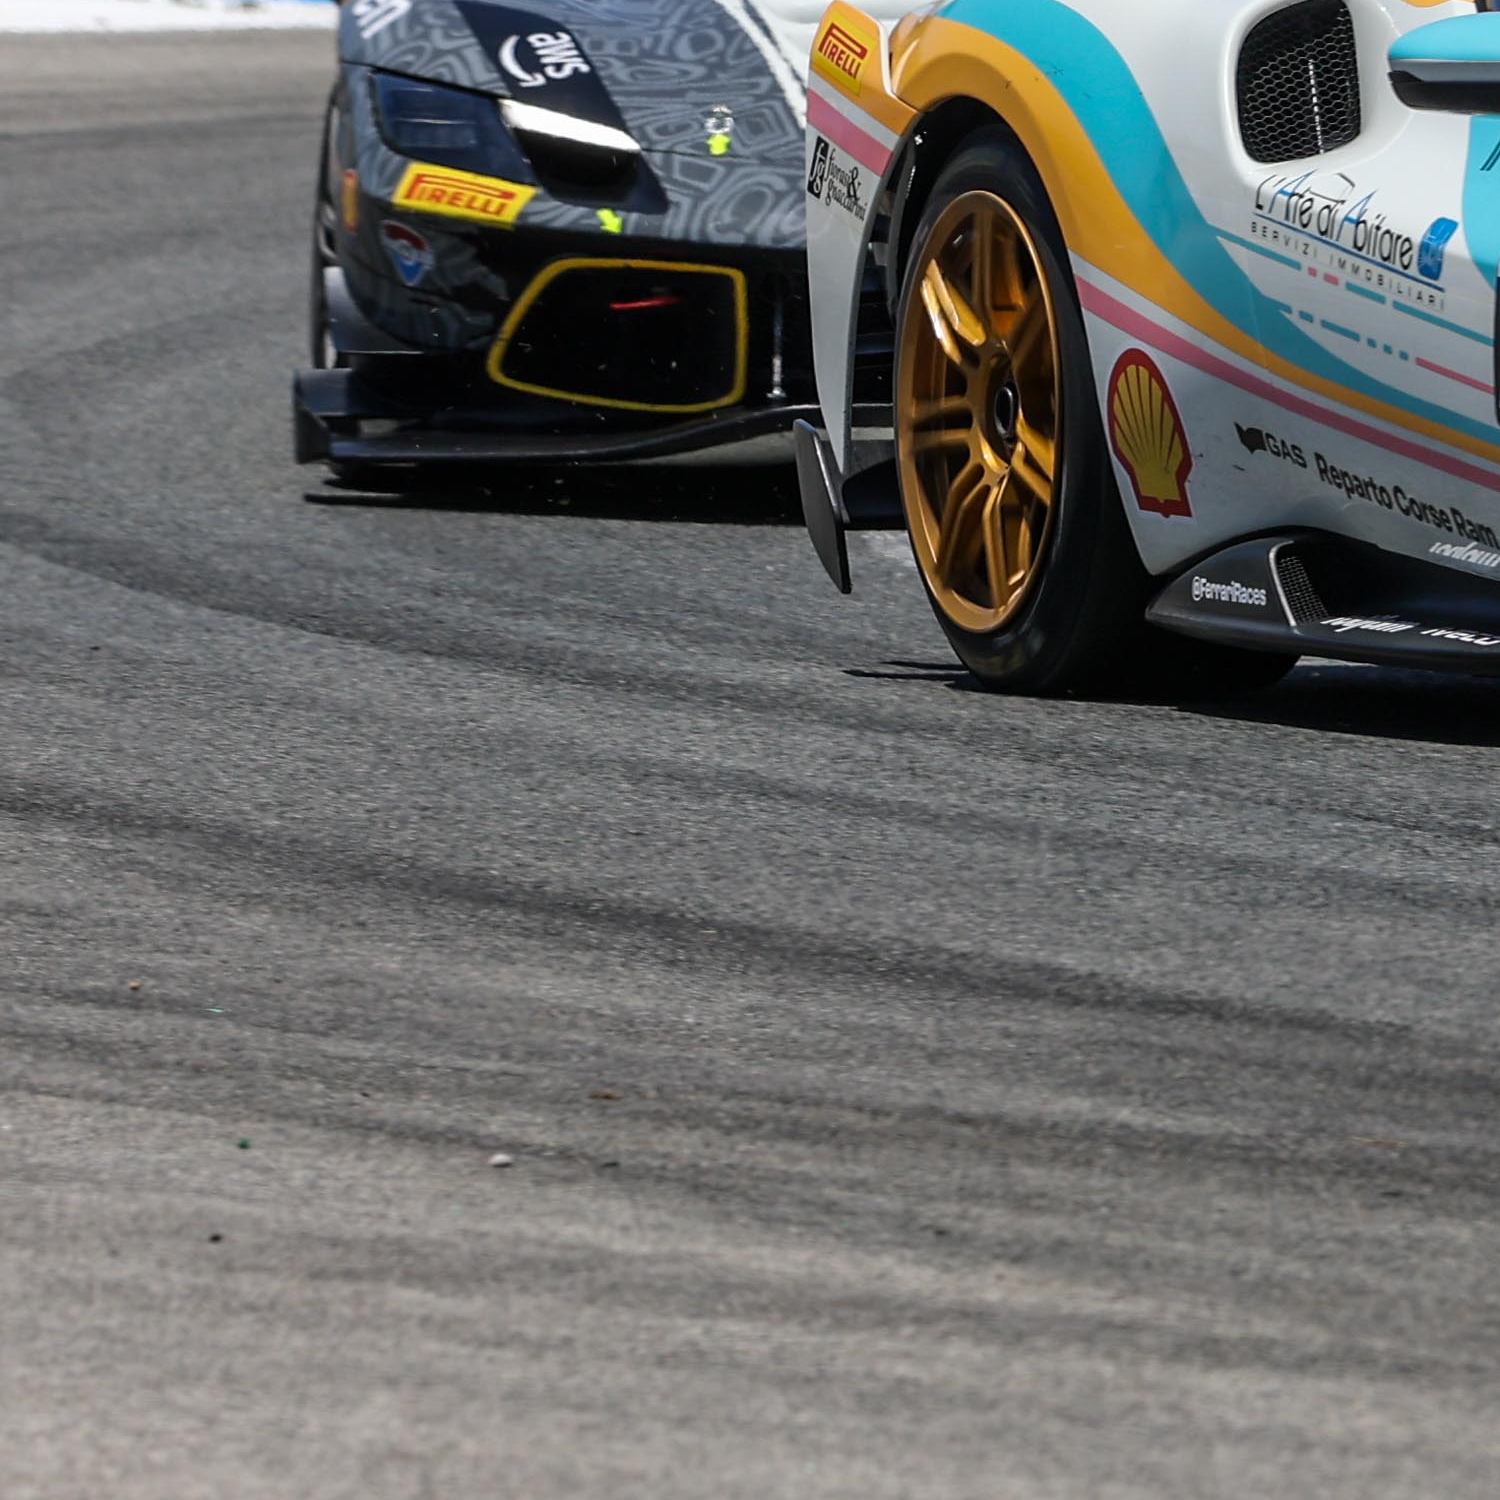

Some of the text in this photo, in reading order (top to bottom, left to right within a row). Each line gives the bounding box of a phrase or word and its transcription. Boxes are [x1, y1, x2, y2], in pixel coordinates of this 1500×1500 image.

[527, 31, 591, 79] aws
[818, 22, 868, 79] PIRELLI
[404, 173, 517, 216] PIRELLI
[1329, 255, 1444, 310] IMMOBILIARI
[1265, 433, 1307, 469] GAS
[1314, 452, 1500, 550] Reparto Corse Ram
[1192, 576, 1267, 606] @FerrariRaces
